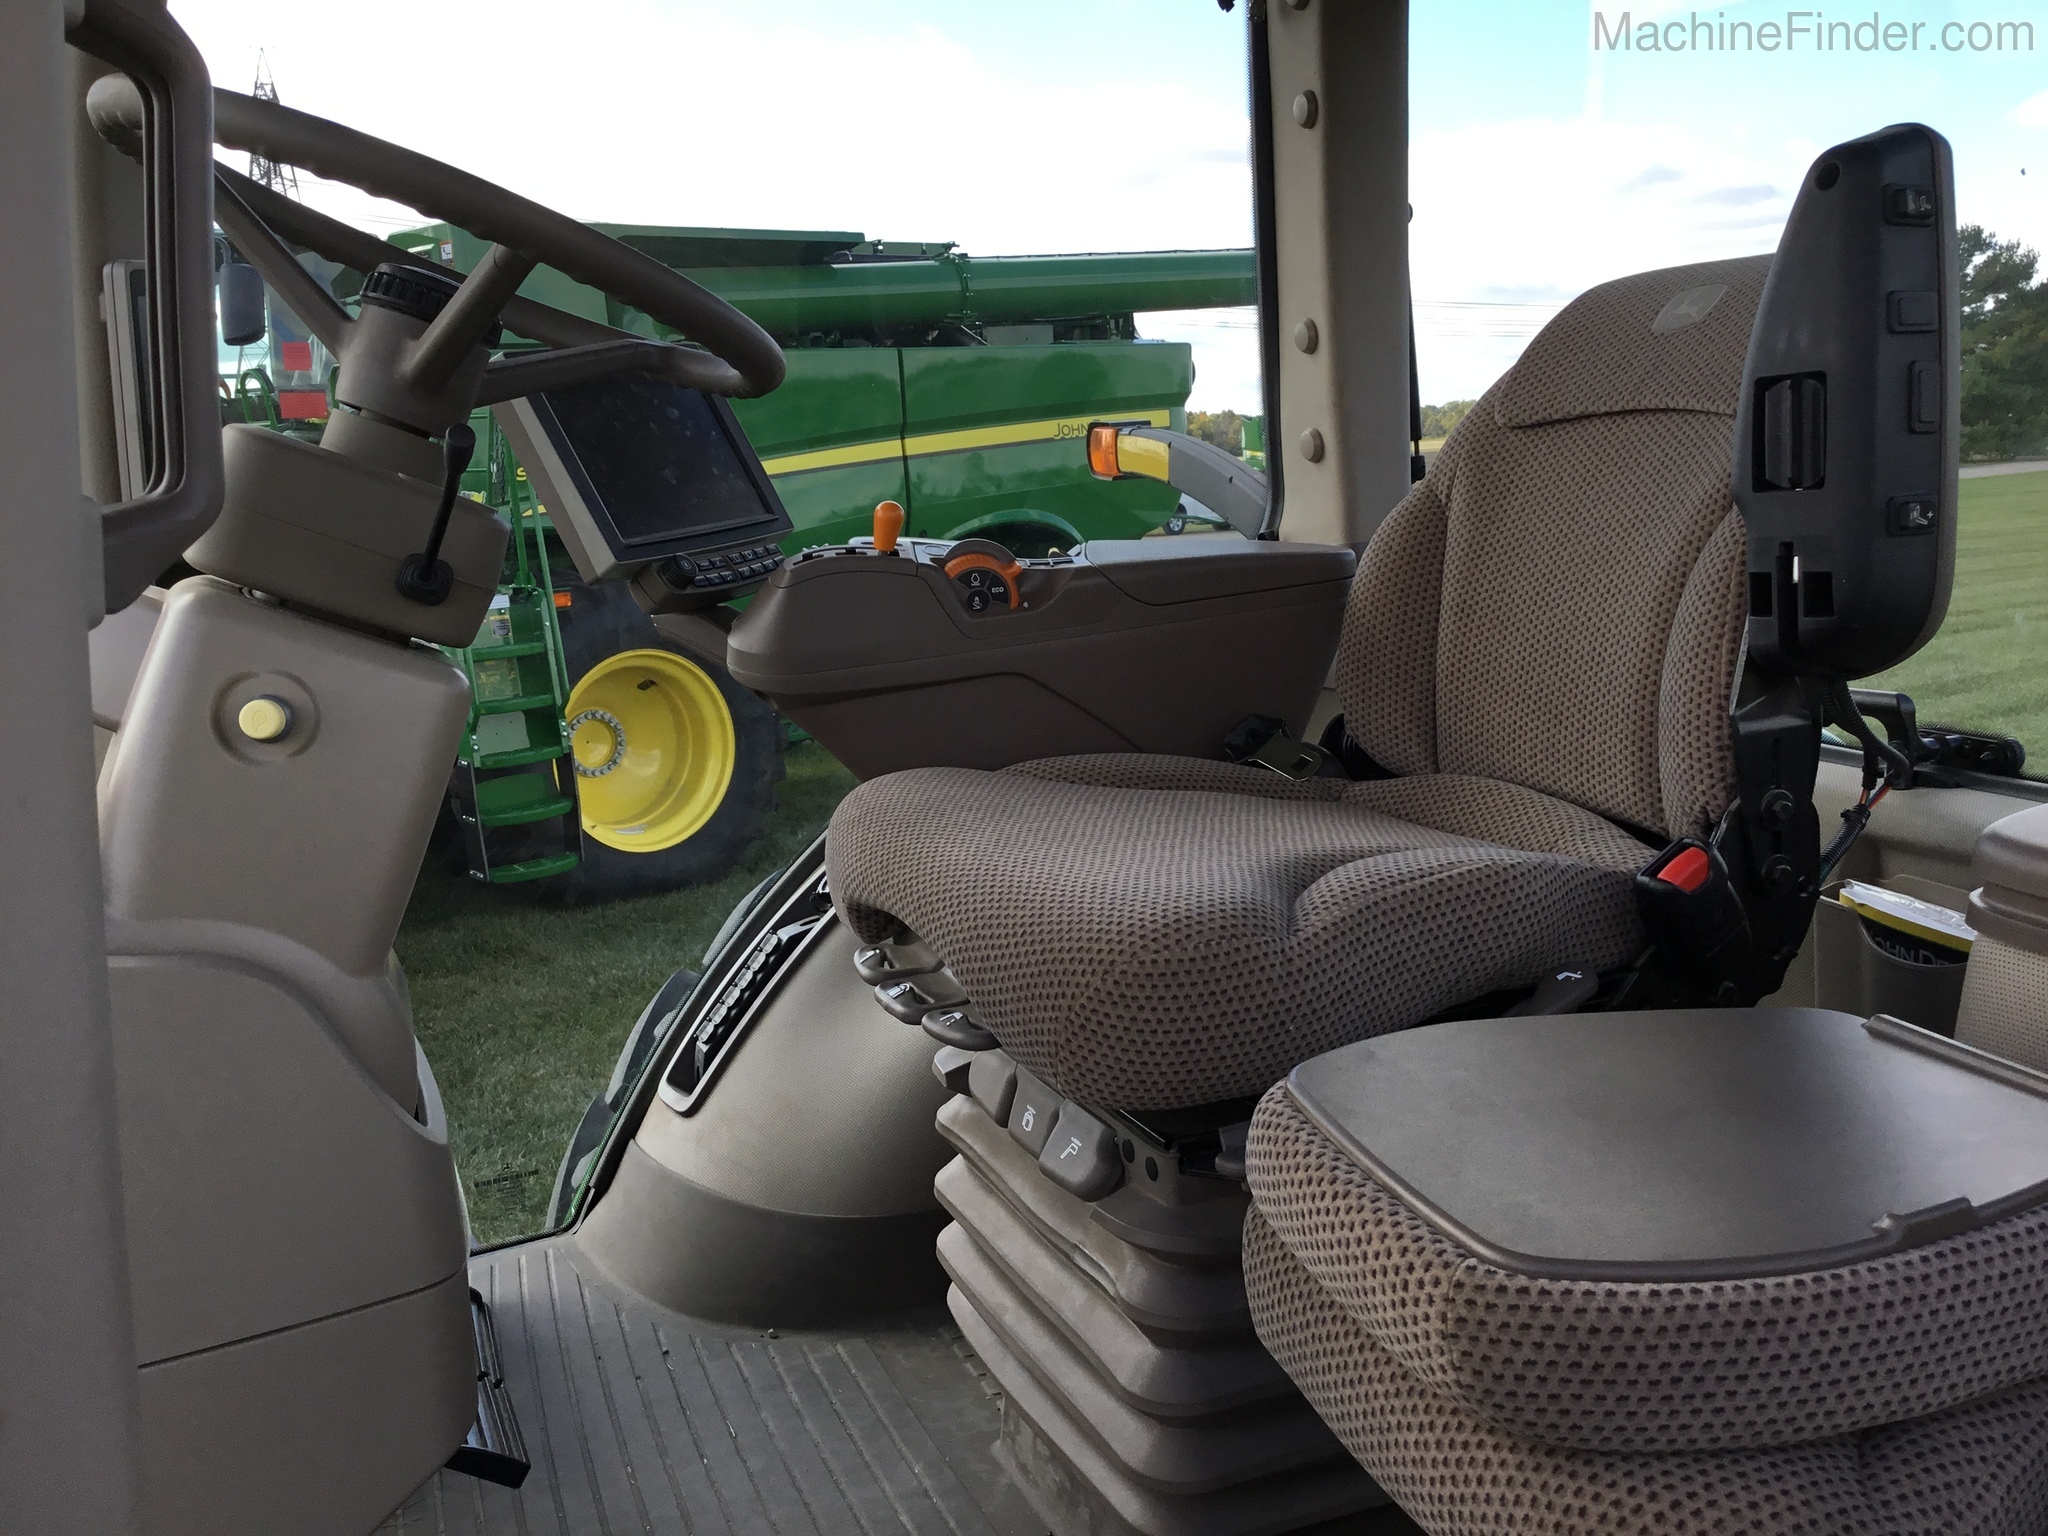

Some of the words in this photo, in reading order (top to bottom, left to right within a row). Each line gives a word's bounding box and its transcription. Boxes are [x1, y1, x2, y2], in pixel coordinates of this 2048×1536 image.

[1053, 422, 1089, 438] JOHN
[991, 586, 1005, 594] ECO
[1870, 930, 1914, 963] OHN
